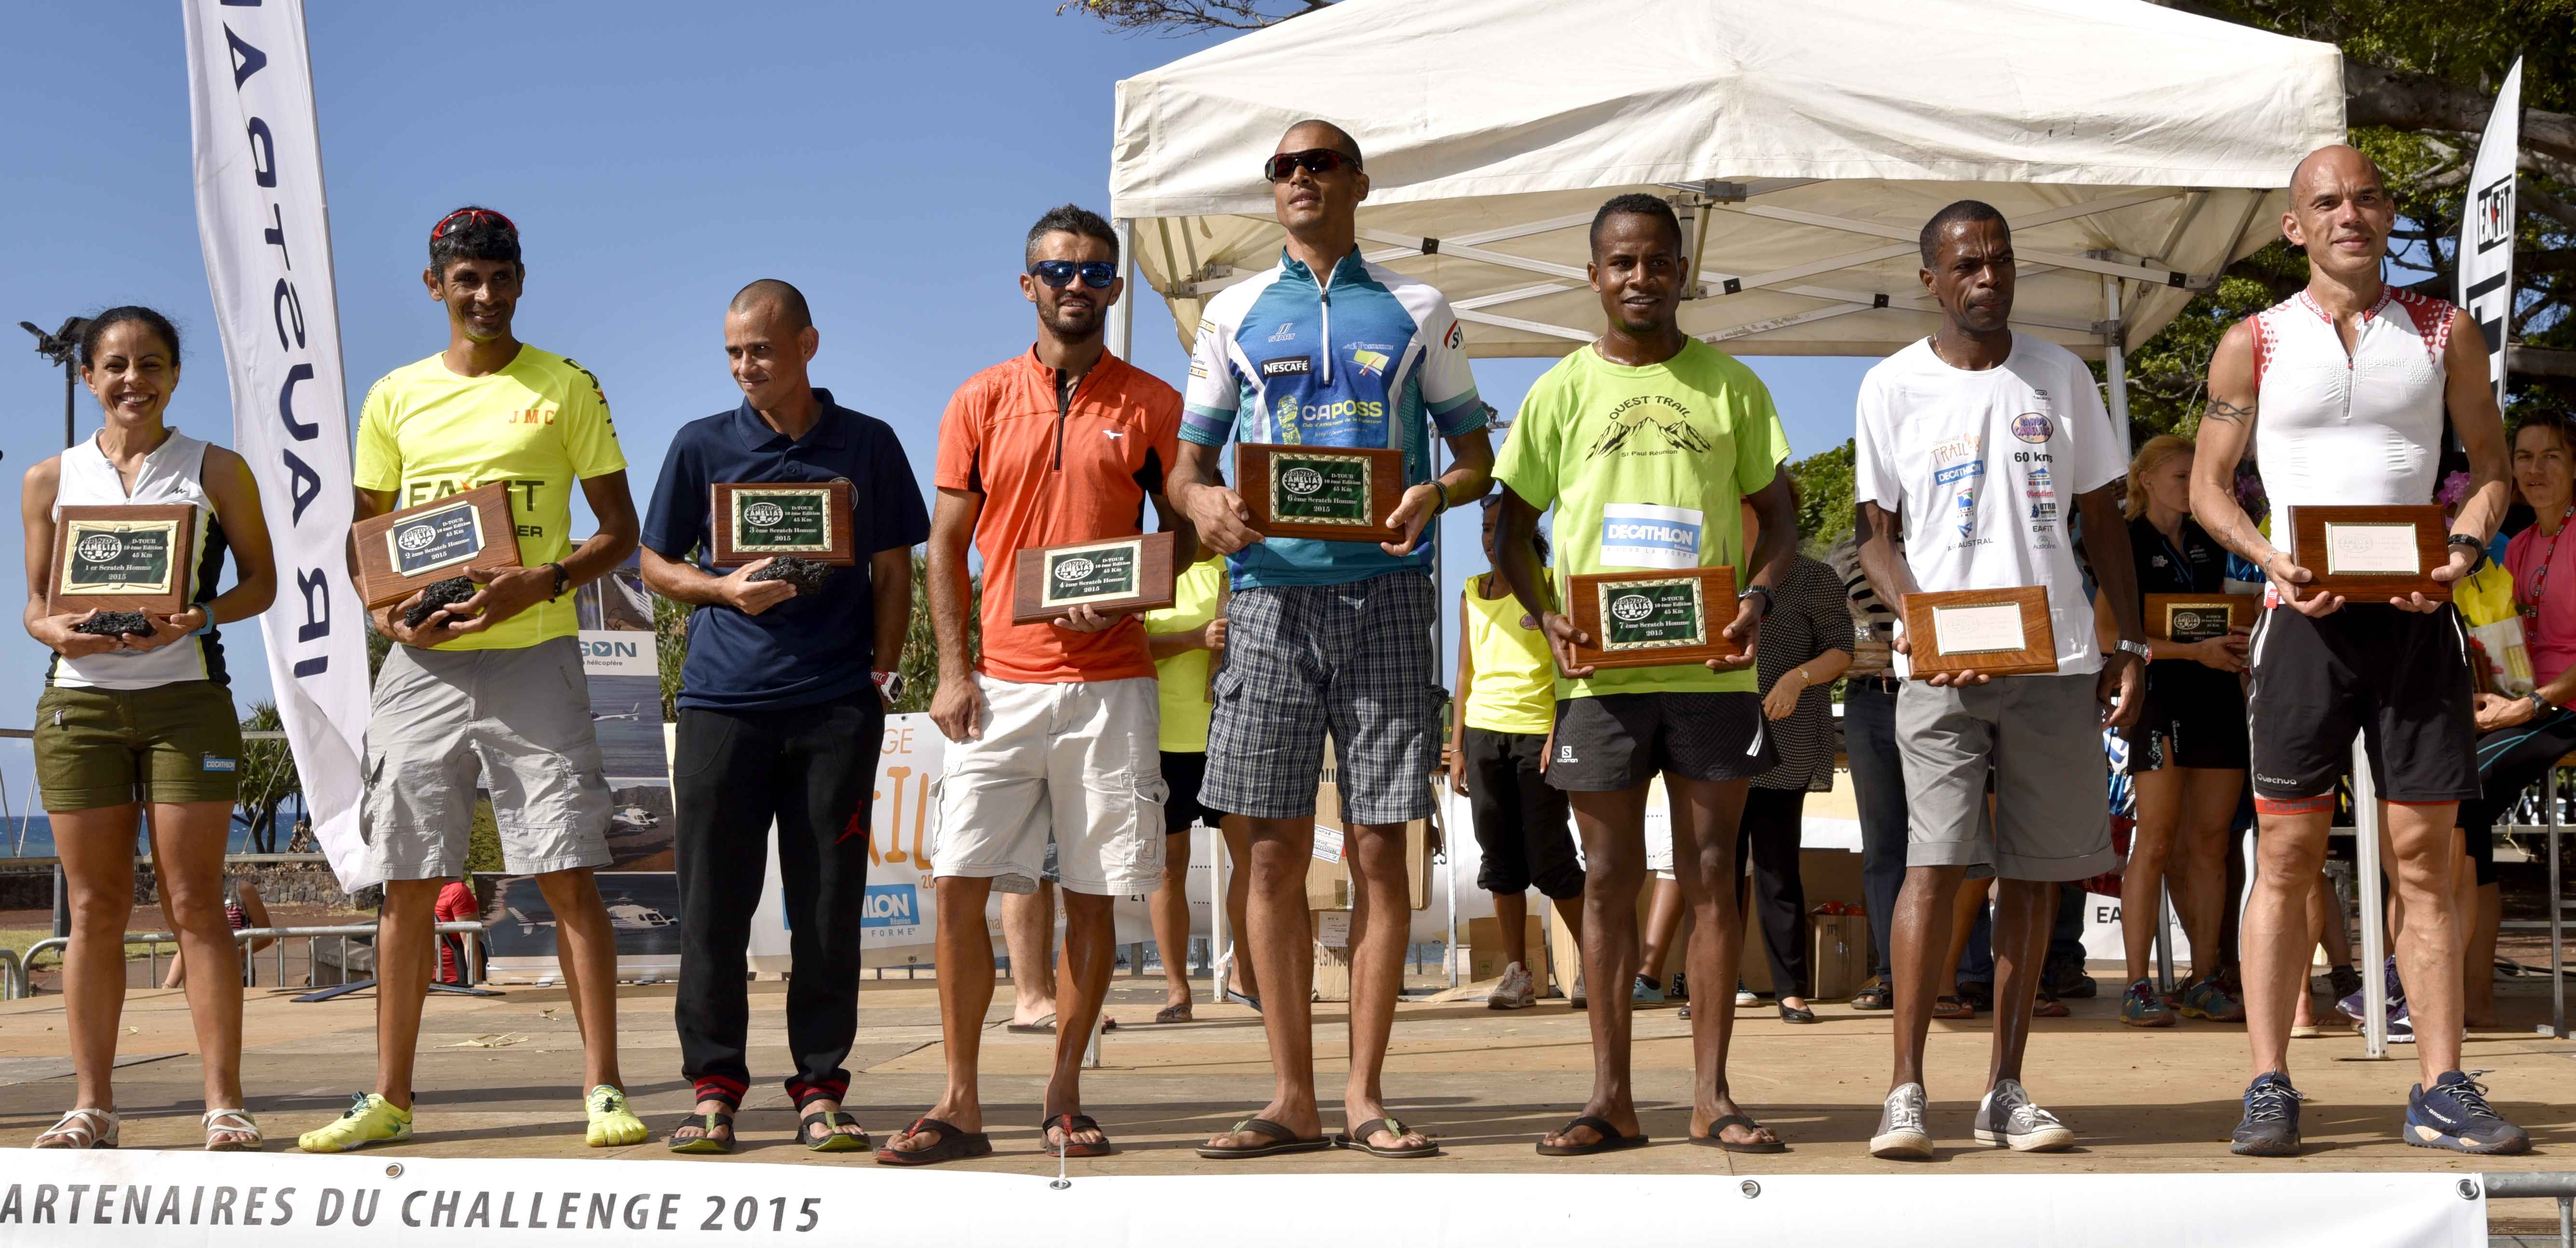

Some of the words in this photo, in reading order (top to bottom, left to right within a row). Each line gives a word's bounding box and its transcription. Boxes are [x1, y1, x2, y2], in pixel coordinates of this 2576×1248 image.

[1268, 333, 1296, 342] START
[1264, 360, 1308, 375] NESCAFÉ
[1302, 400, 1383, 421] CAPOSS
[1609, 396, 1650, 420] OUEST
[1655, 396, 1691, 418] TRAIL
[1931, 443, 1970, 464] TRAIL
[2014, 452, 2029, 462] 60
[442, 517, 463, 526] D-TOUR
[1608, 524, 1693, 545] DECATHLON
[425, 543, 447, 553] Scratch
[448, 538, 470, 547] Homme
[1959, 537, 1993, 548] AUSTRAL
[2257, 773, 2297, 785] Quechua
[0, 1184, 296, 1227] ARTENAIRES
[315, 1188, 381, 1227] DU
[401, 1190, 682, 1230] CHALLENGE
[700, 1195, 822, 1233] 2015
